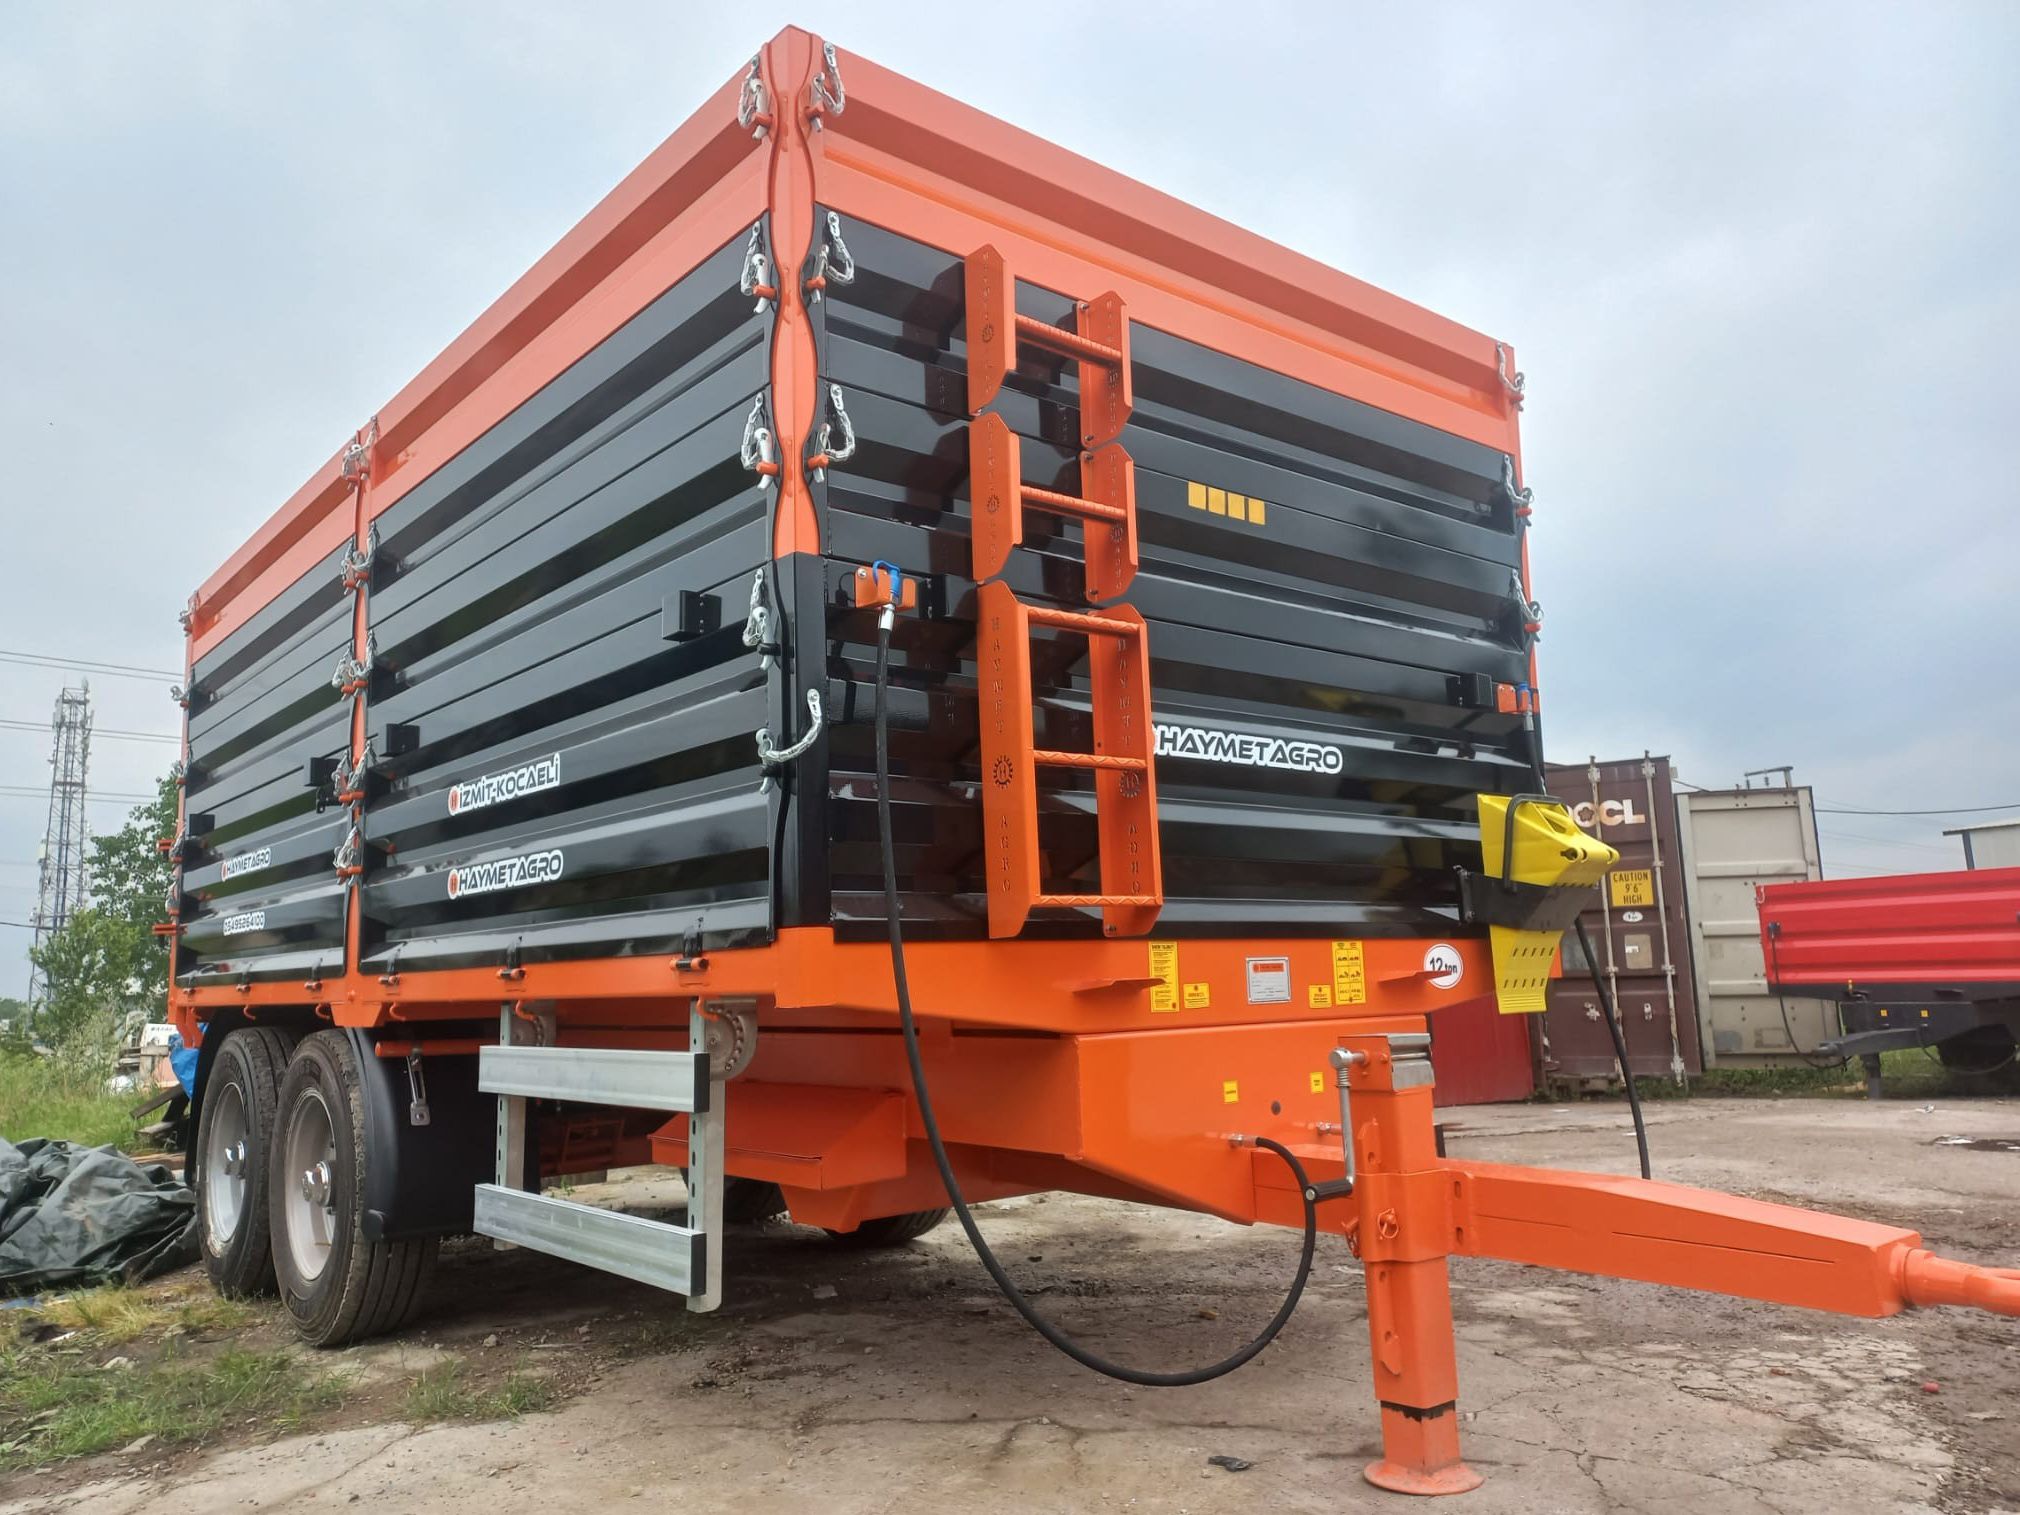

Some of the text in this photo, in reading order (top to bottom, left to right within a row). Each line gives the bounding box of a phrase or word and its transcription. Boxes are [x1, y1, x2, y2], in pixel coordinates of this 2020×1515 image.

[1158, 730, 1341, 770] HAYMETAGRO
[459, 758, 560, 809] İZMİT-KOCAELİ
[1567, 798, 1646, 828] OCL
[459, 853, 562, 892] HAYMETAGRO
[1612, 871, 1649, 882] CAUTION
[1623, 894, 1643, 905] HIGH
[1429, 956, 1443, 972] 12
